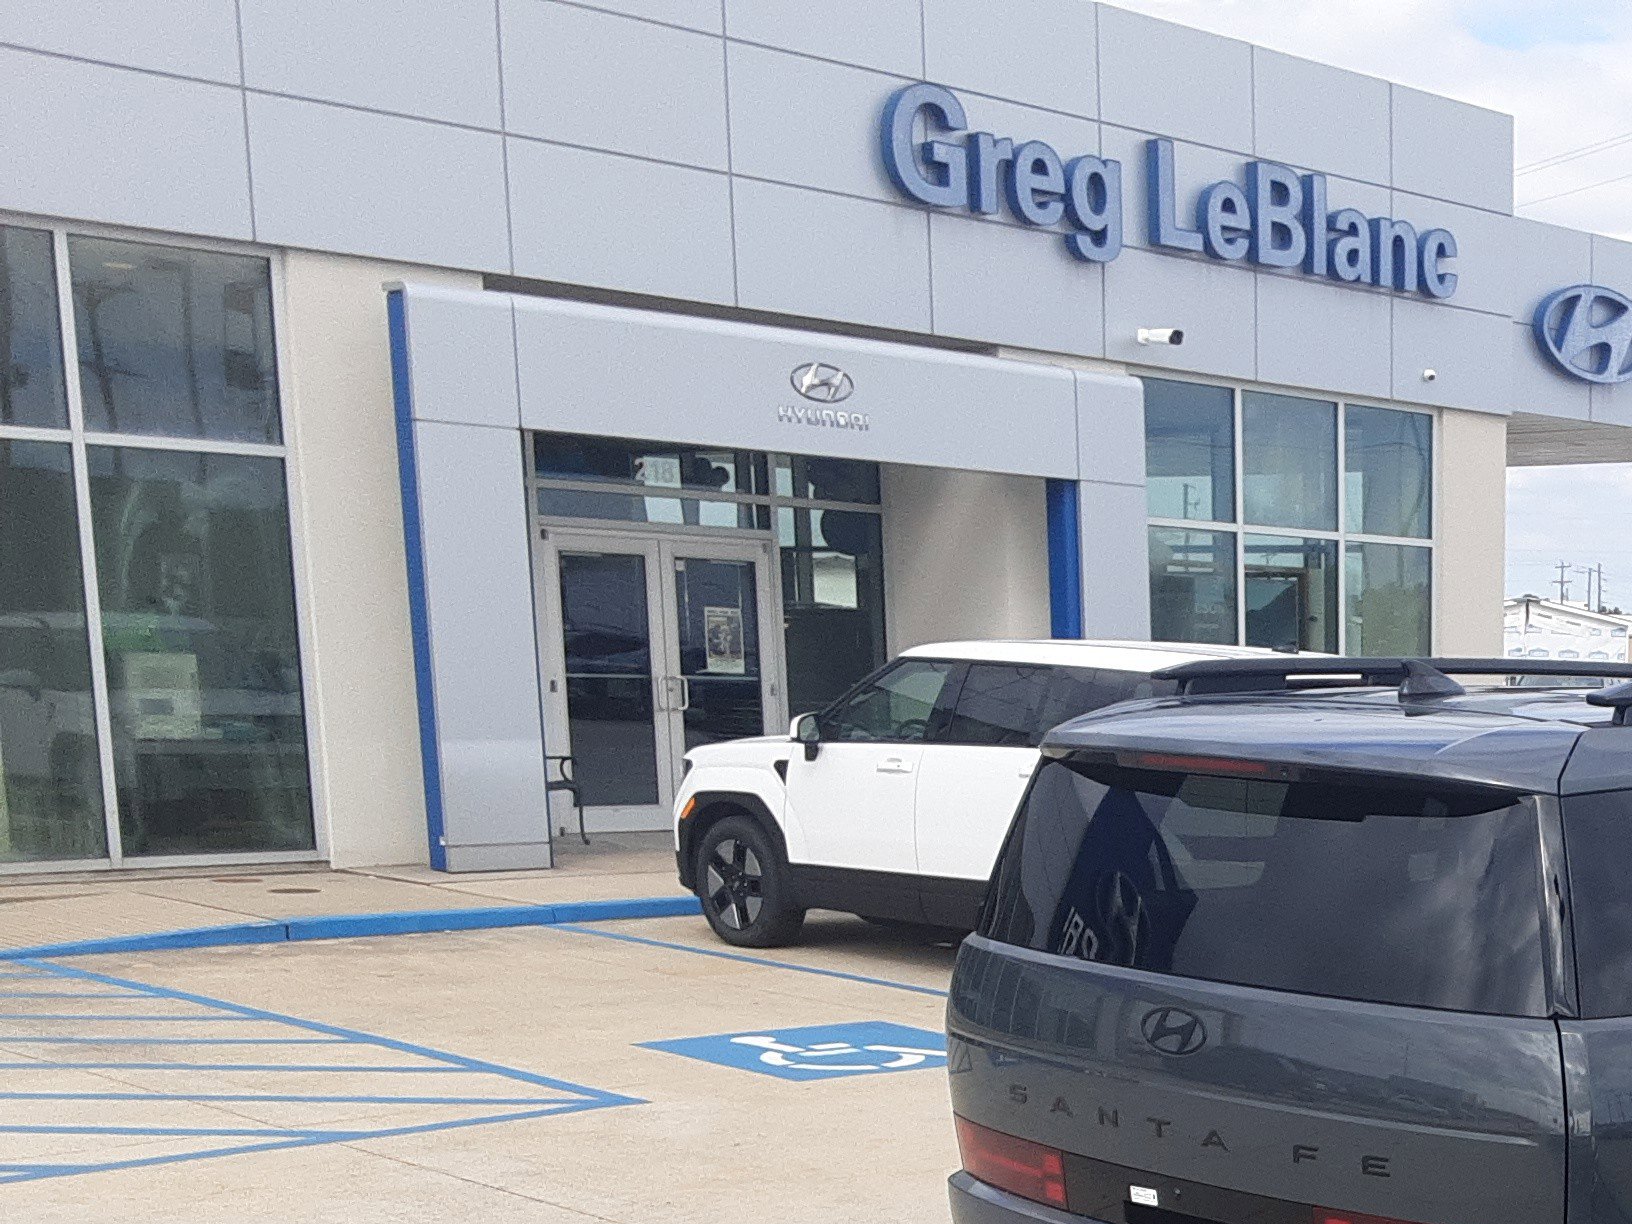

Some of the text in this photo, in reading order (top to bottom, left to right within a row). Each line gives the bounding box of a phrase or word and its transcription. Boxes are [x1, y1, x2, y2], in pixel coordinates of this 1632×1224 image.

[881, 82, 1458, 299] Greg LeBlanc
[777, 405, 870, 431] HYUNDAI
[1007, 1083, 1392, 1178] SANTA FE
